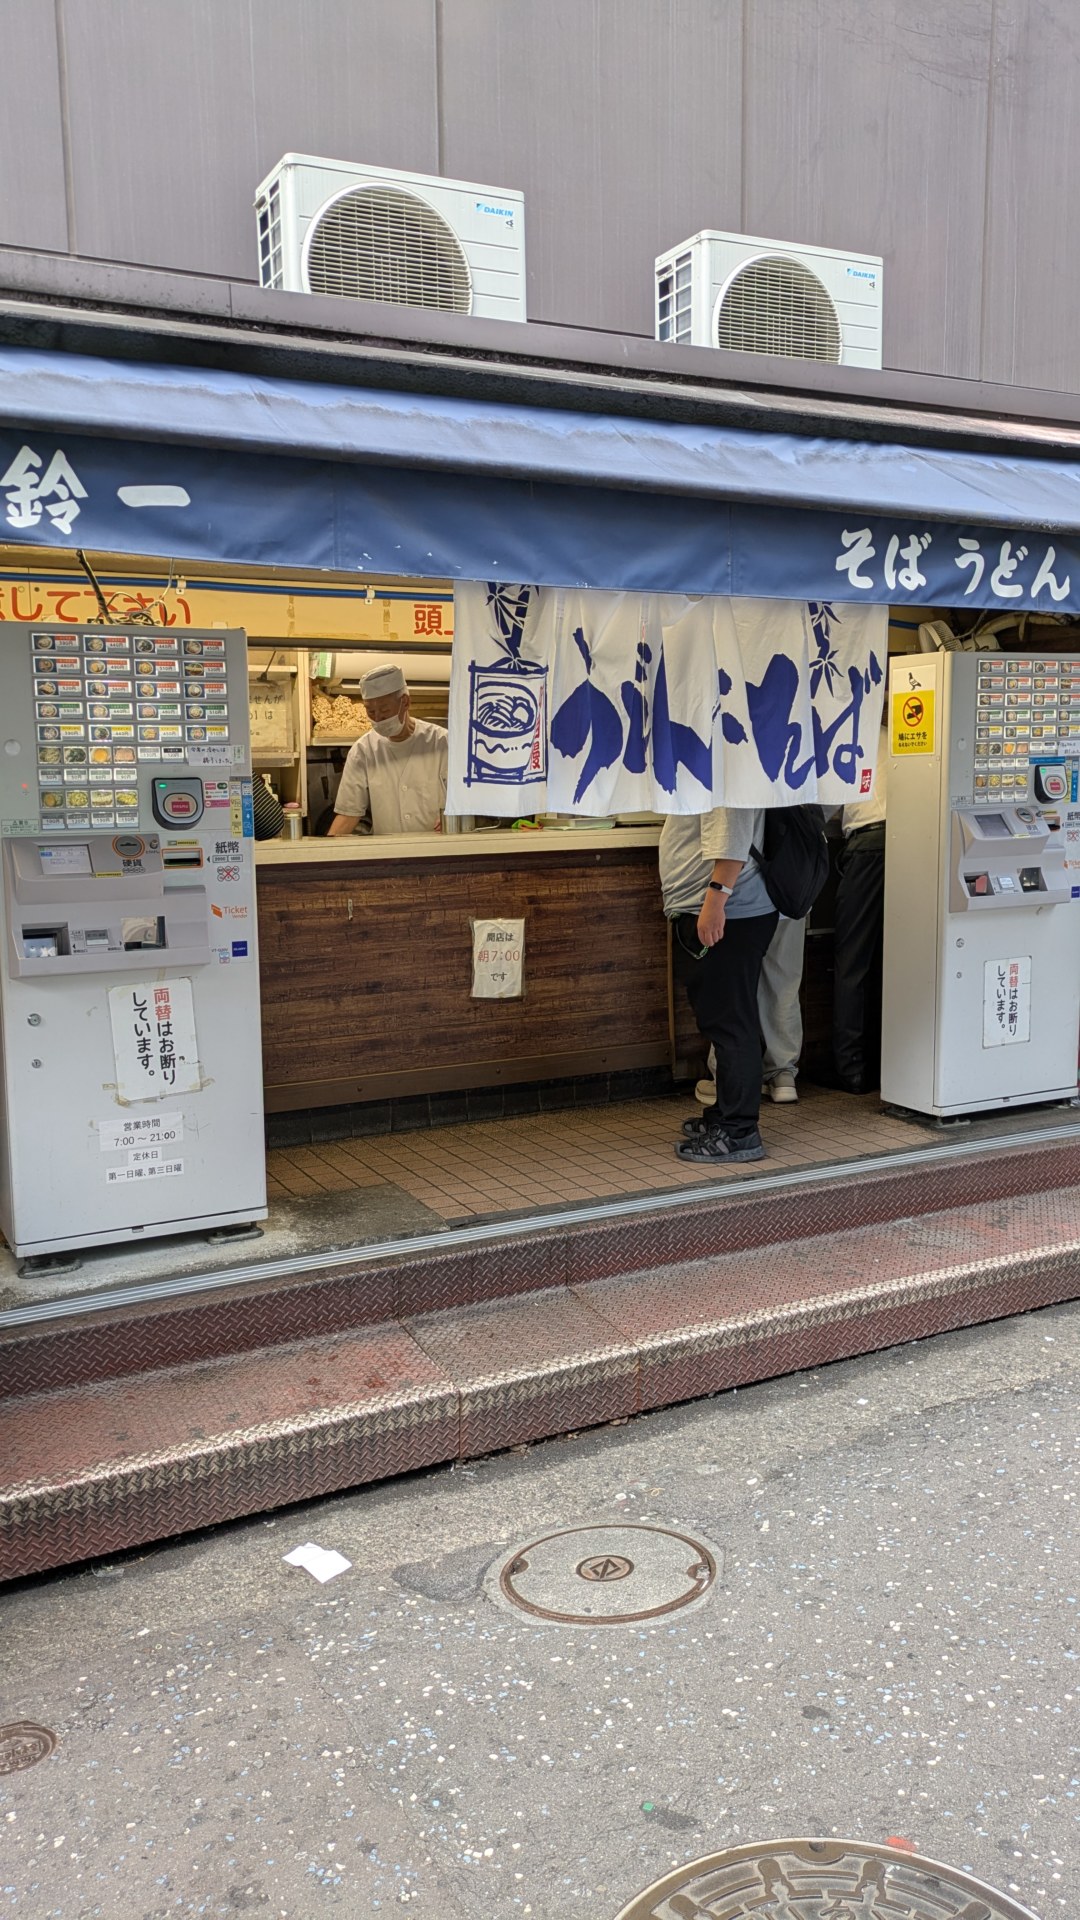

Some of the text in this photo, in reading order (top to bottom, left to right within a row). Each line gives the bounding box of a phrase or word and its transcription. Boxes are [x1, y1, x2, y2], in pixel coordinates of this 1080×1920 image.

[484, 205, 514, 217] DAIKIN
[852, 270, 876, 280] DAIKIN
[835, 528, 1071, 602] そば うどん
[0, 586, 191, 623] して下さい
[414, 604, 454, 636] 頭
[215, 840, 240, 854] 紙幣
[122, 859, 142, 867] 硬貨
[223, 905, 248, 914] Ticket
[487, 933, 514, 942] 開店は
[478, 950, 520, 963] 朝7:00
[491, 972, 507, 982] です
[996, 965, 1006, 1030] しています。
[1008, 963, 1019, 1036] 両替はお断り
[132, 991, 155, 1077] しています。
[153, 987, 177, 1086] 両替はお断り
[123, 1119, 161, 1132] 営業時間
[114, 1135, 135, 1147] 7:00
[150, 1130, 176, 1143] 21:00
[133, 1151, 159, 1162] 定休日
[108, 1163, 182, 1182] 第一日曜、第三日曜
